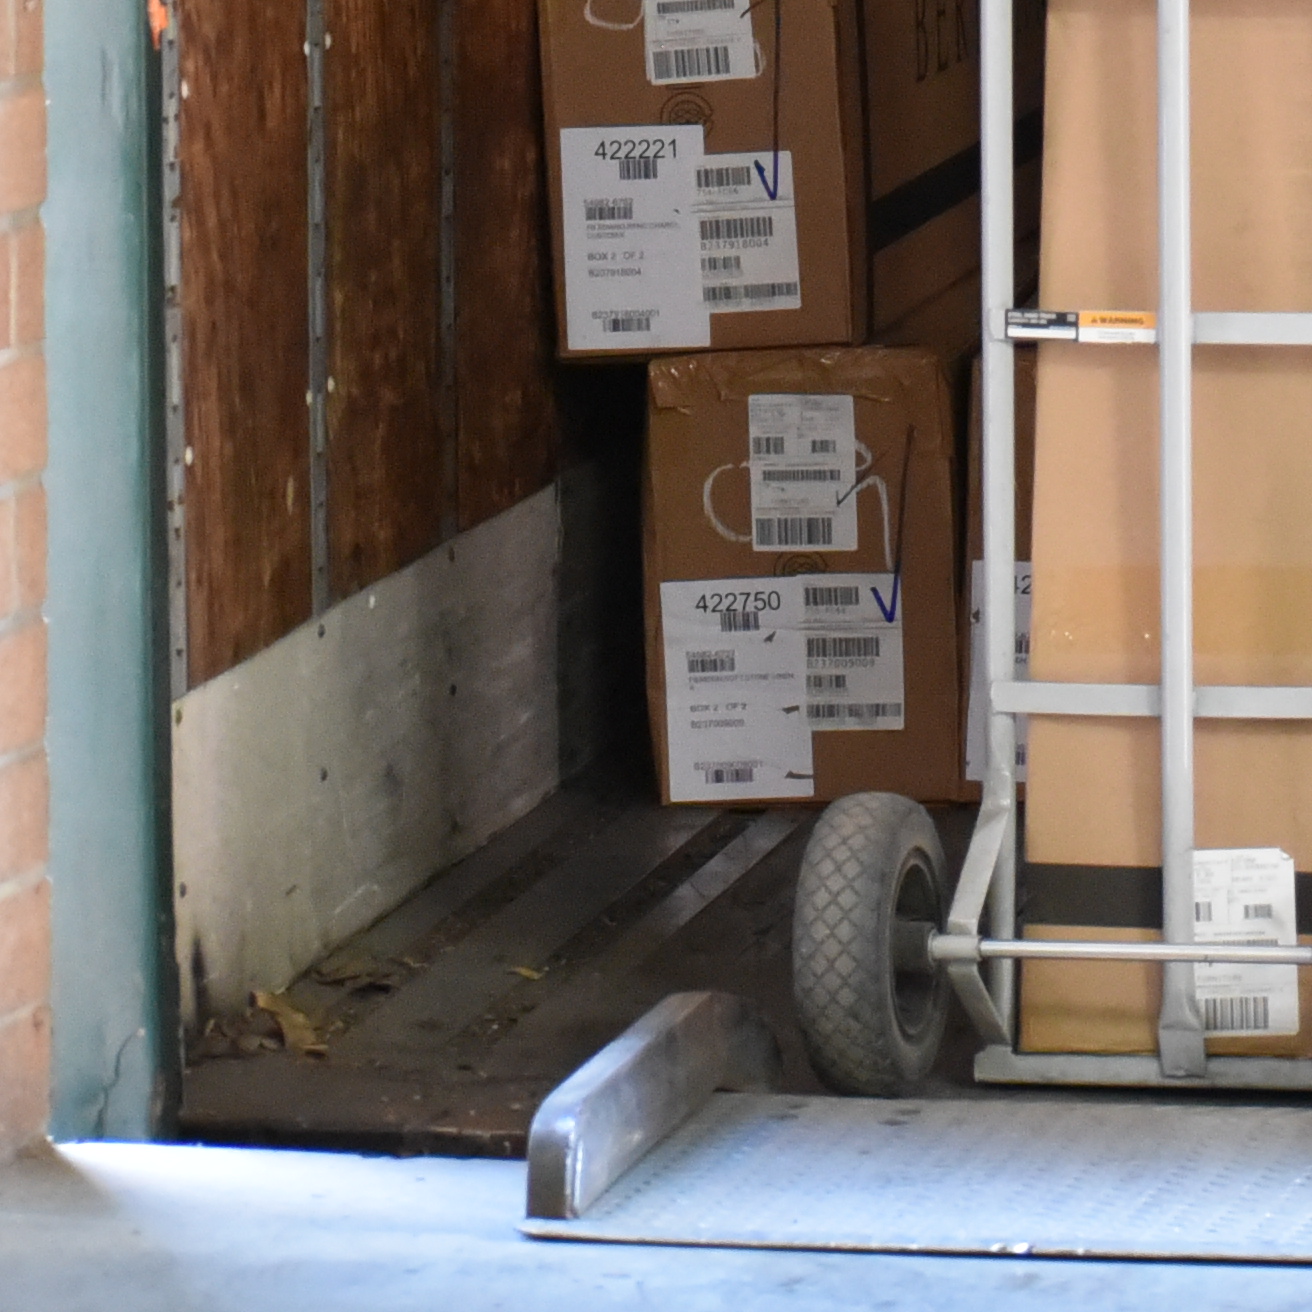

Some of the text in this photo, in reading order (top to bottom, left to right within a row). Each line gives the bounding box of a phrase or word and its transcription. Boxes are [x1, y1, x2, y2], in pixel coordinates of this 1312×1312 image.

[594, 138, 677, 160] 422221
[587, 252, 609, 262] BOX
[1100, 316, 1144, 325] WARNING
[695, 590, 781, 613] 422750
